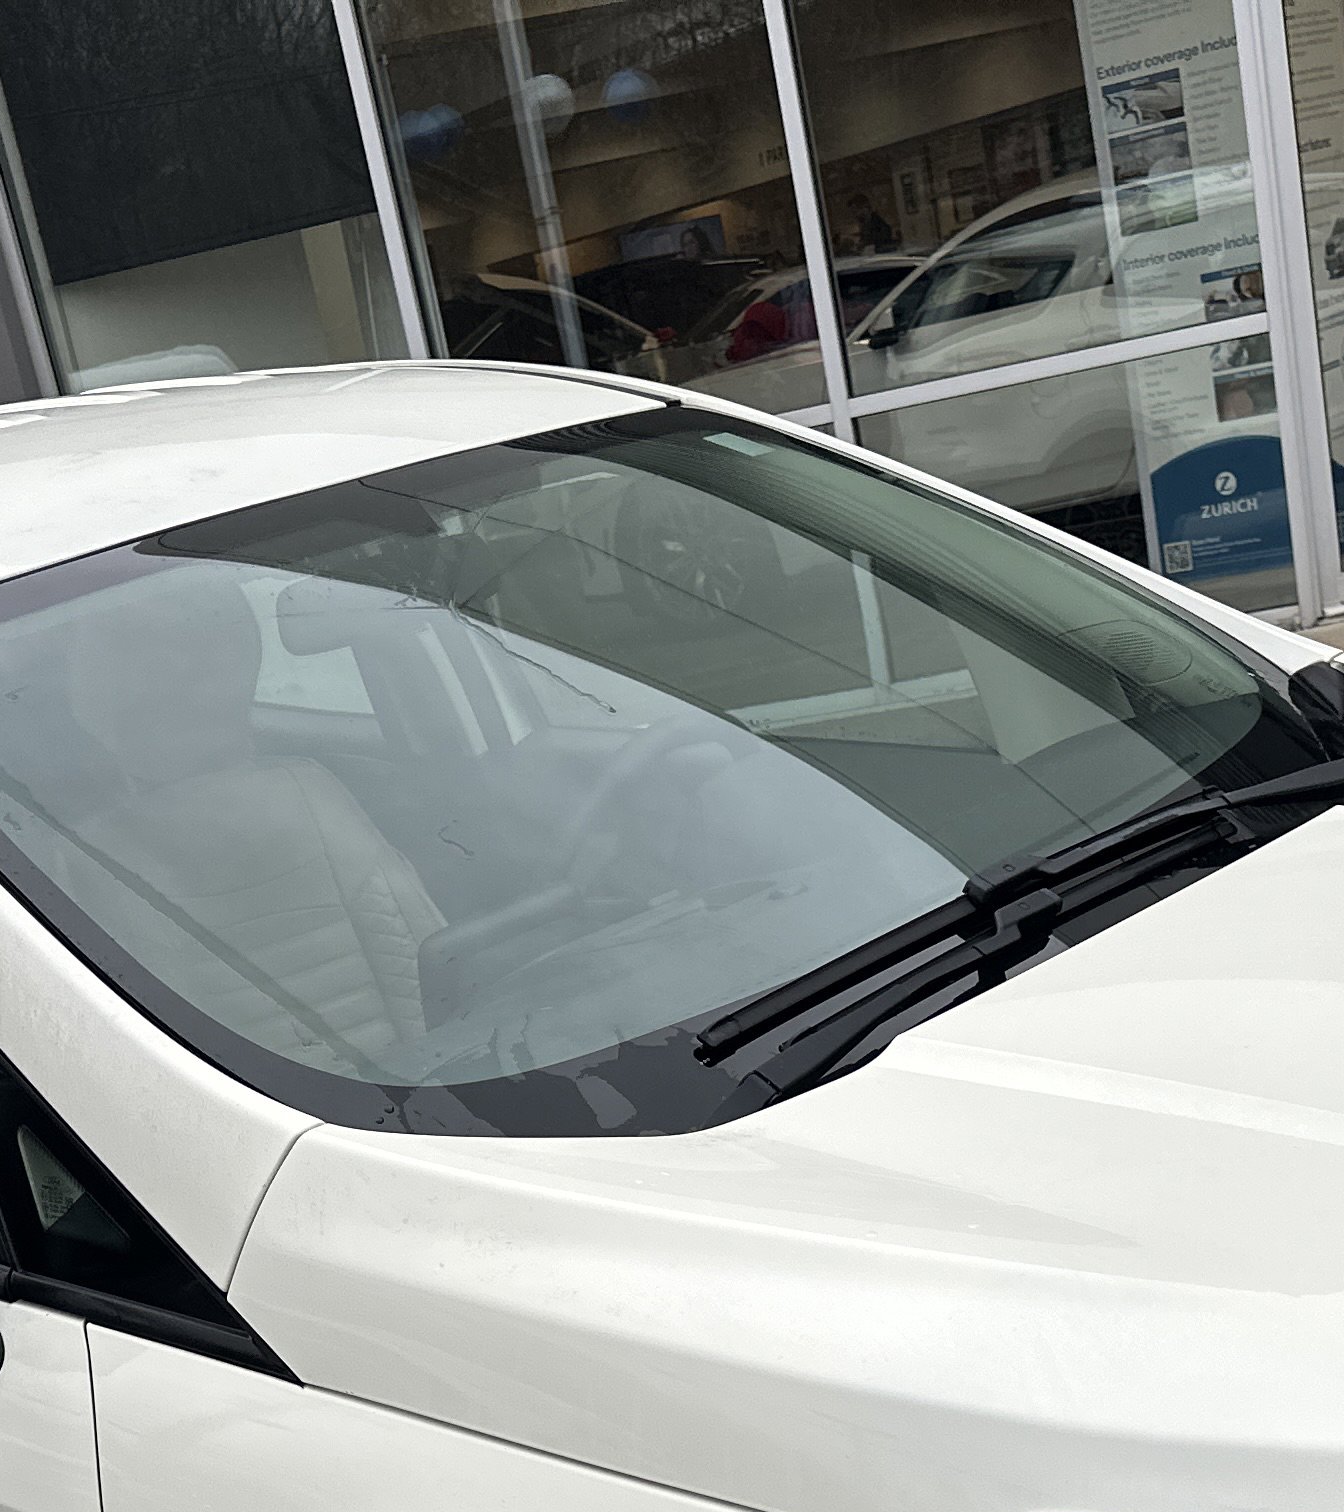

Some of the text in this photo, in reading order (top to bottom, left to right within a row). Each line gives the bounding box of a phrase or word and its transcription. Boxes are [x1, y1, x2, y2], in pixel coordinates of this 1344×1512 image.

[1096, 58, 1141, 80] Exterior
[1144, 45, 1199, 68] coverage
[1122, 253, 1166, 271] Interior
[1167, 242, 1223, 263] coverage
[1200, 498, 1258, 519] ZURICH
